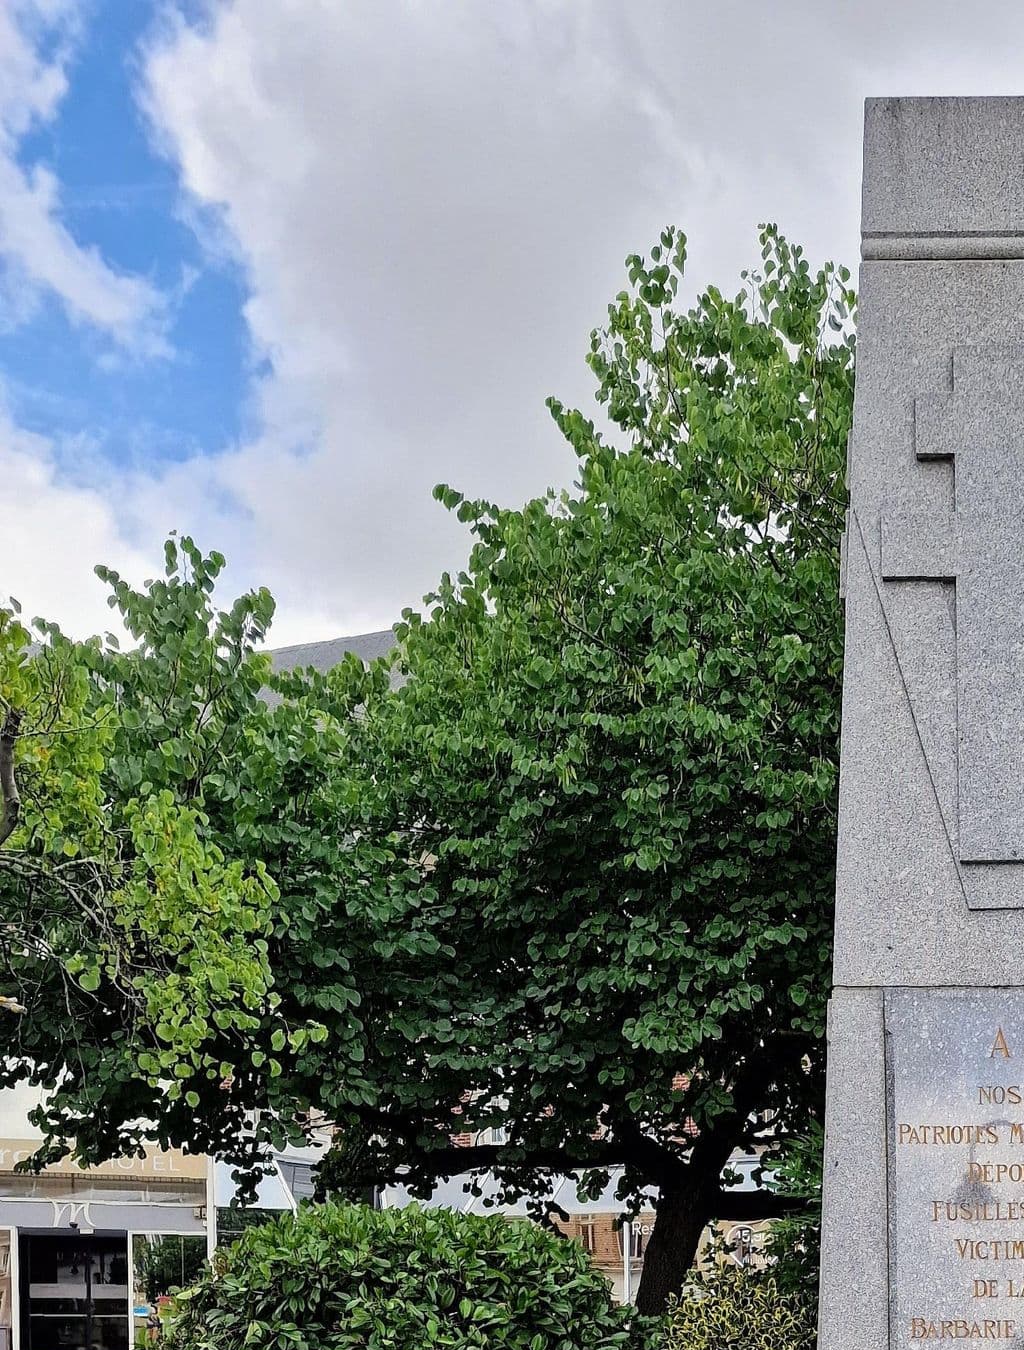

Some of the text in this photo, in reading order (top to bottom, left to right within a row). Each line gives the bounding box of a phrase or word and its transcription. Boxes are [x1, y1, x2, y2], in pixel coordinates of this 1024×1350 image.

[989, 1026, 1011, 1058] A
[977, 1085, 1022, 1105] NOS
[898, 1122, 999, 1145] PATRIOTES
[972, 1278, 998, 1298] DE
[910, 1317, 1016, 1339] BARBARIE
